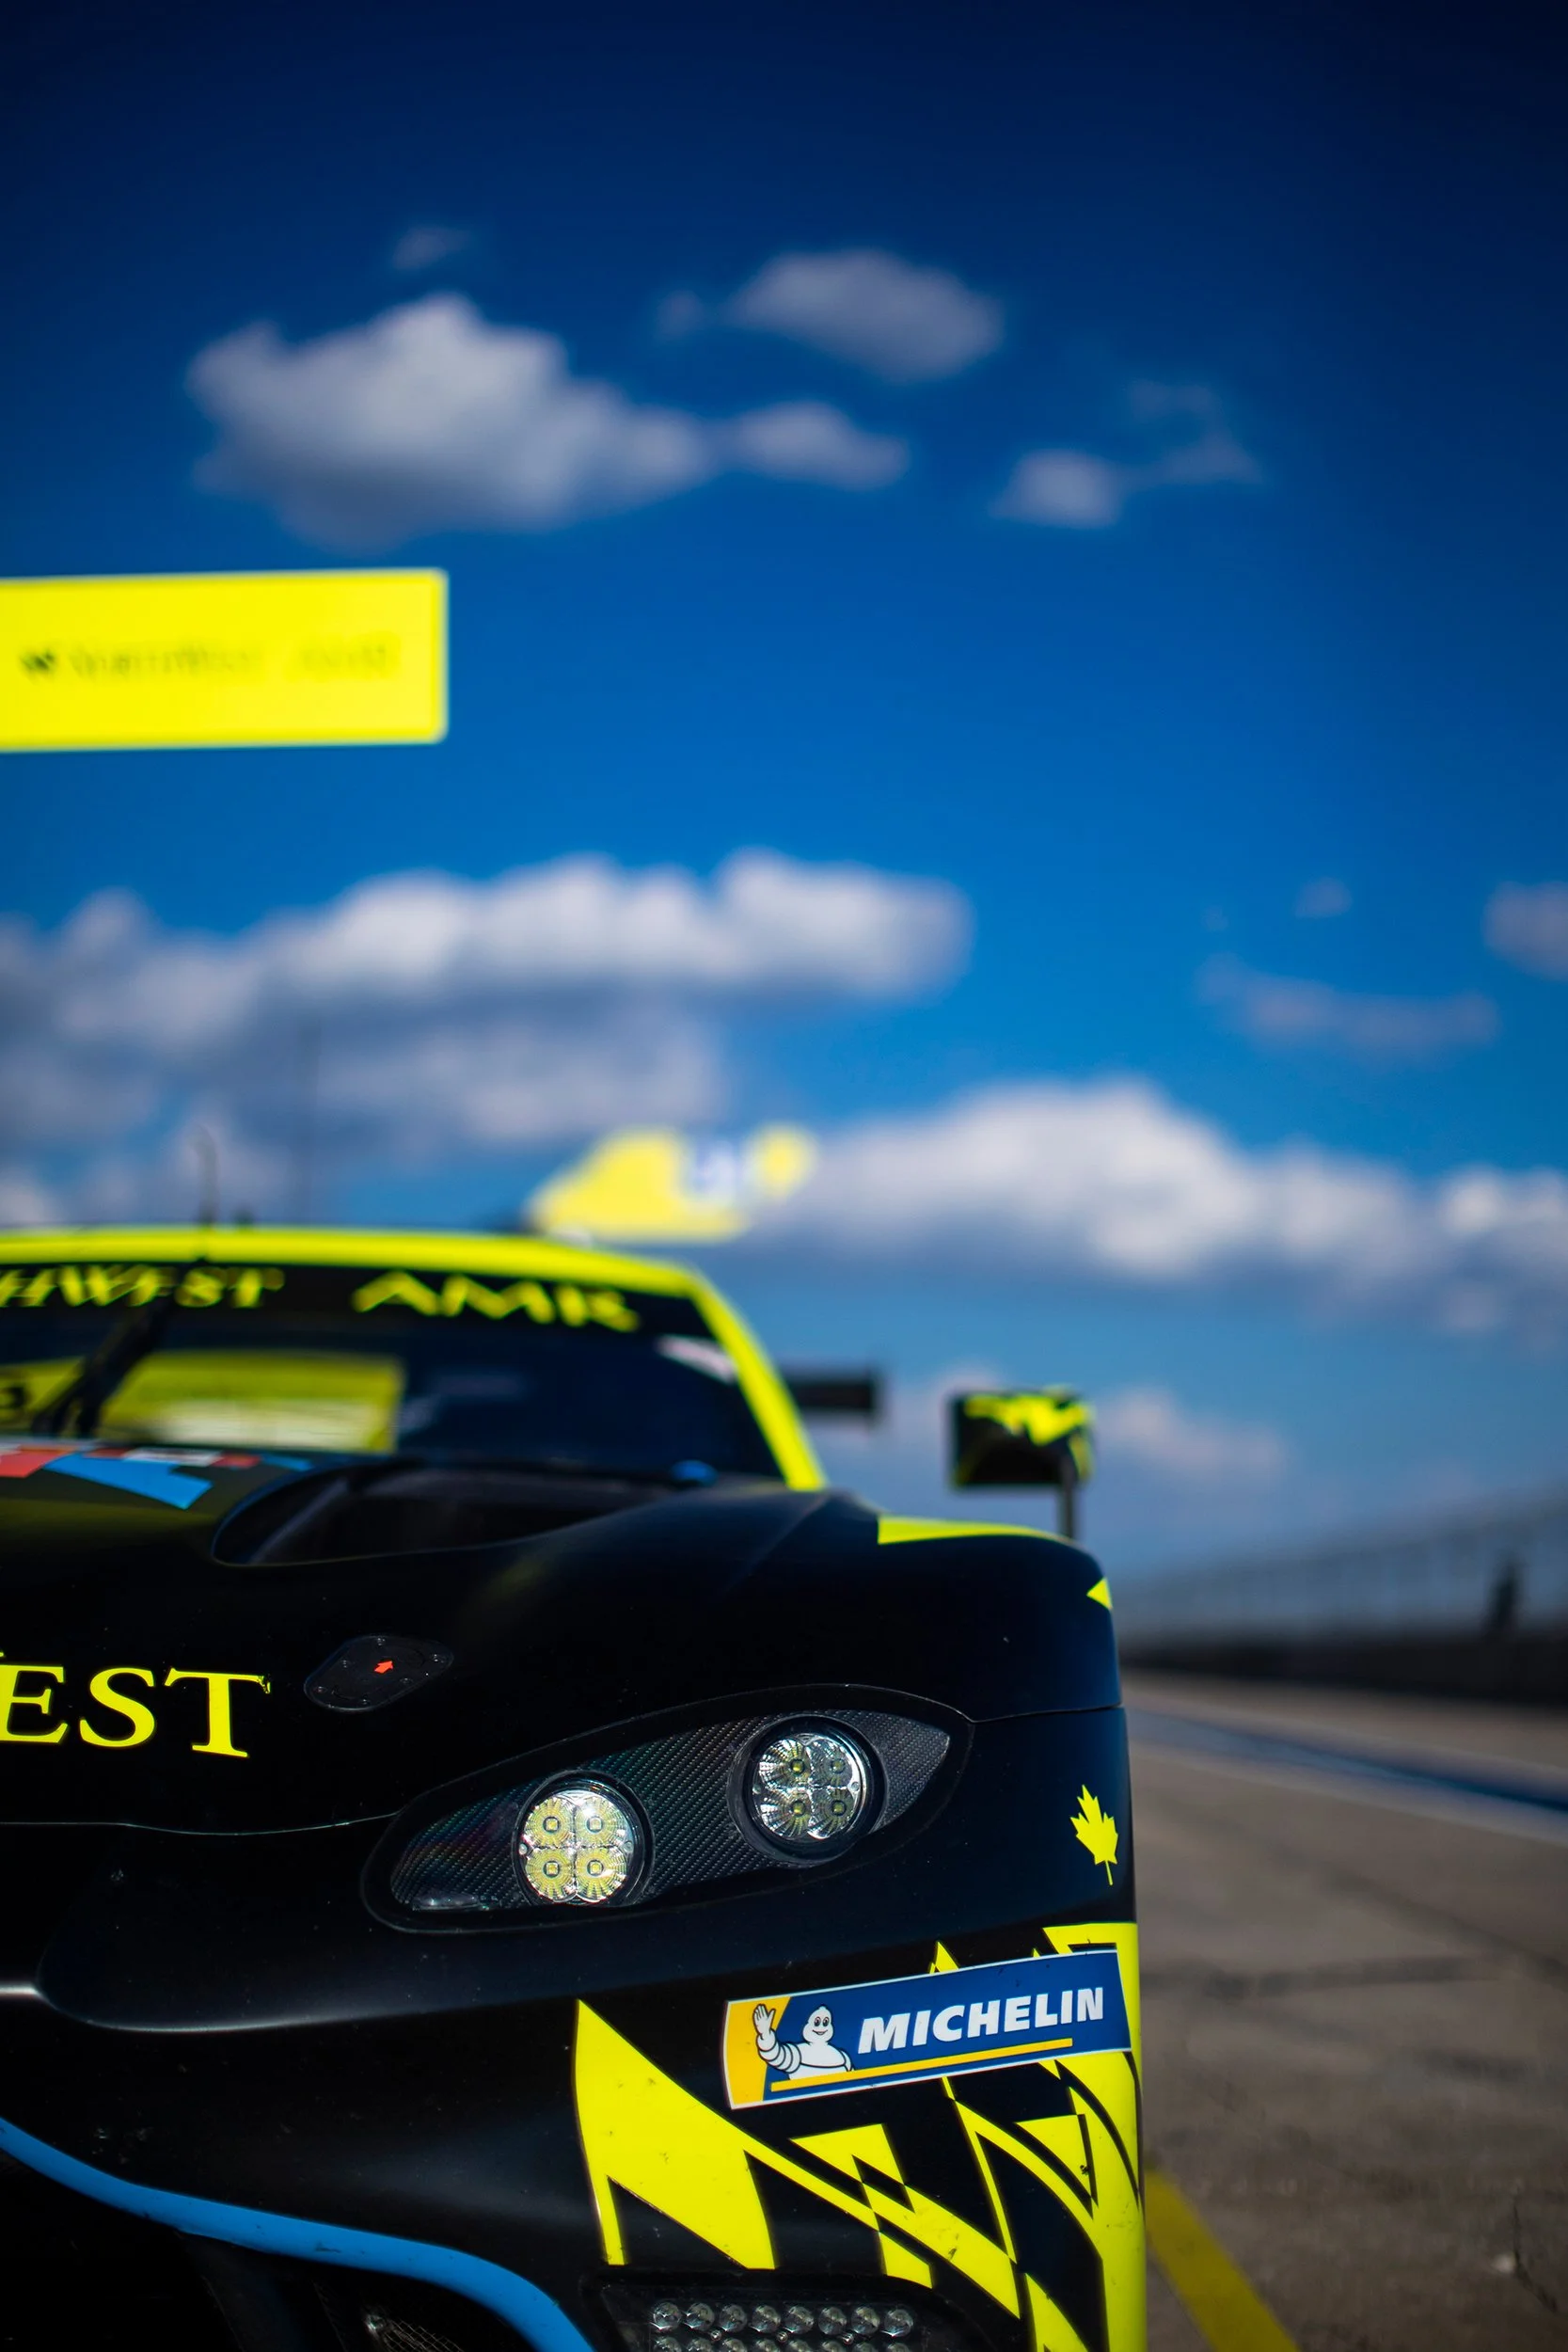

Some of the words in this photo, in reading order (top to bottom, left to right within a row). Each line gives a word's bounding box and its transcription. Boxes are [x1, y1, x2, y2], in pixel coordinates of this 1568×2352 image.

[351, 1270, 641, 1332] AMR
[0, 1664, 271, 1757] EST
[858, 1987, 1104, 2055] MICHELIN
